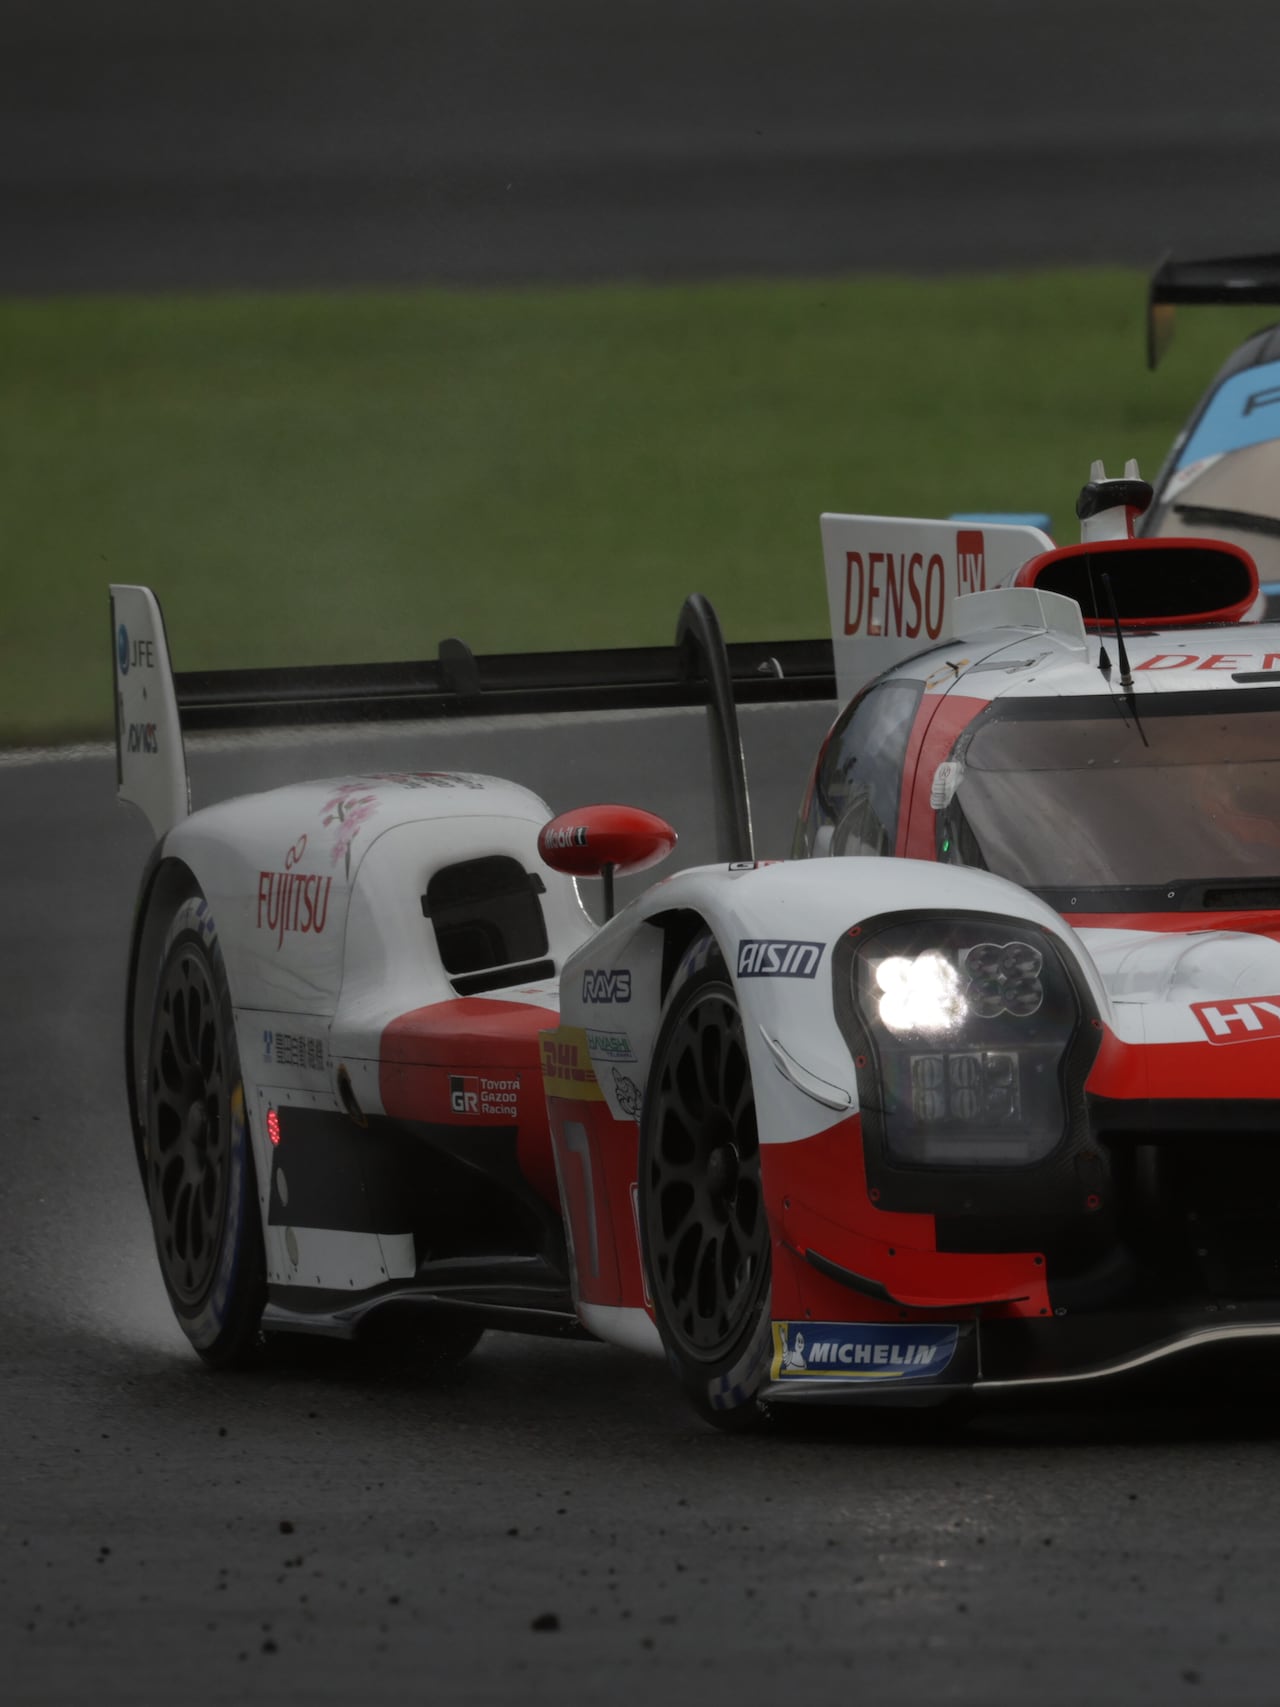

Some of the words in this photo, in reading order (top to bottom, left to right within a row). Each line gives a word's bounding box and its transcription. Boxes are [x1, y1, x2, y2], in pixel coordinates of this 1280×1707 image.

[844, 551, 945, 640] DENSO
[131, 640, 155, 668] JFE
[544, 827, 574, 848] Mobil
[256, 870, 333, 952] FUJITSU
[738, 943, 822, 976] AISIN
[583, 970, 631, 1002] RAYS
[480, 1078, 521, 1091] TOYOTA
[451, 1091, 479, 1115] GR
[480, 1091, 518, 1104] GAZOO
[481, 1103, 518, 1117] Racing
[808, 1342, 937, 1366] MICHELIN
